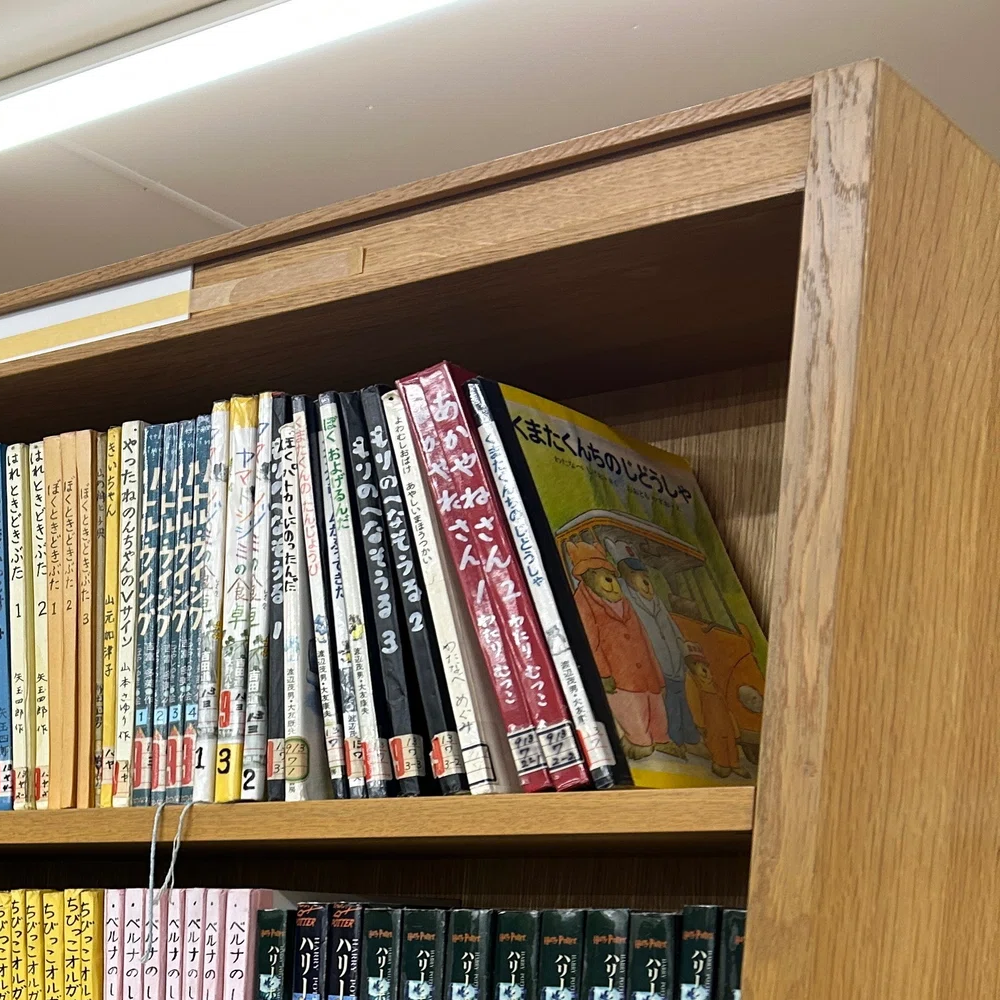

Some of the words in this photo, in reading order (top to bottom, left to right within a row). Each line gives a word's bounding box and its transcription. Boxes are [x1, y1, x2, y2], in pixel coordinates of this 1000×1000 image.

[195, 747, 205, 769] 1
[217, 748, 231, 774] 3
[243, 769, 256, 790] 2
